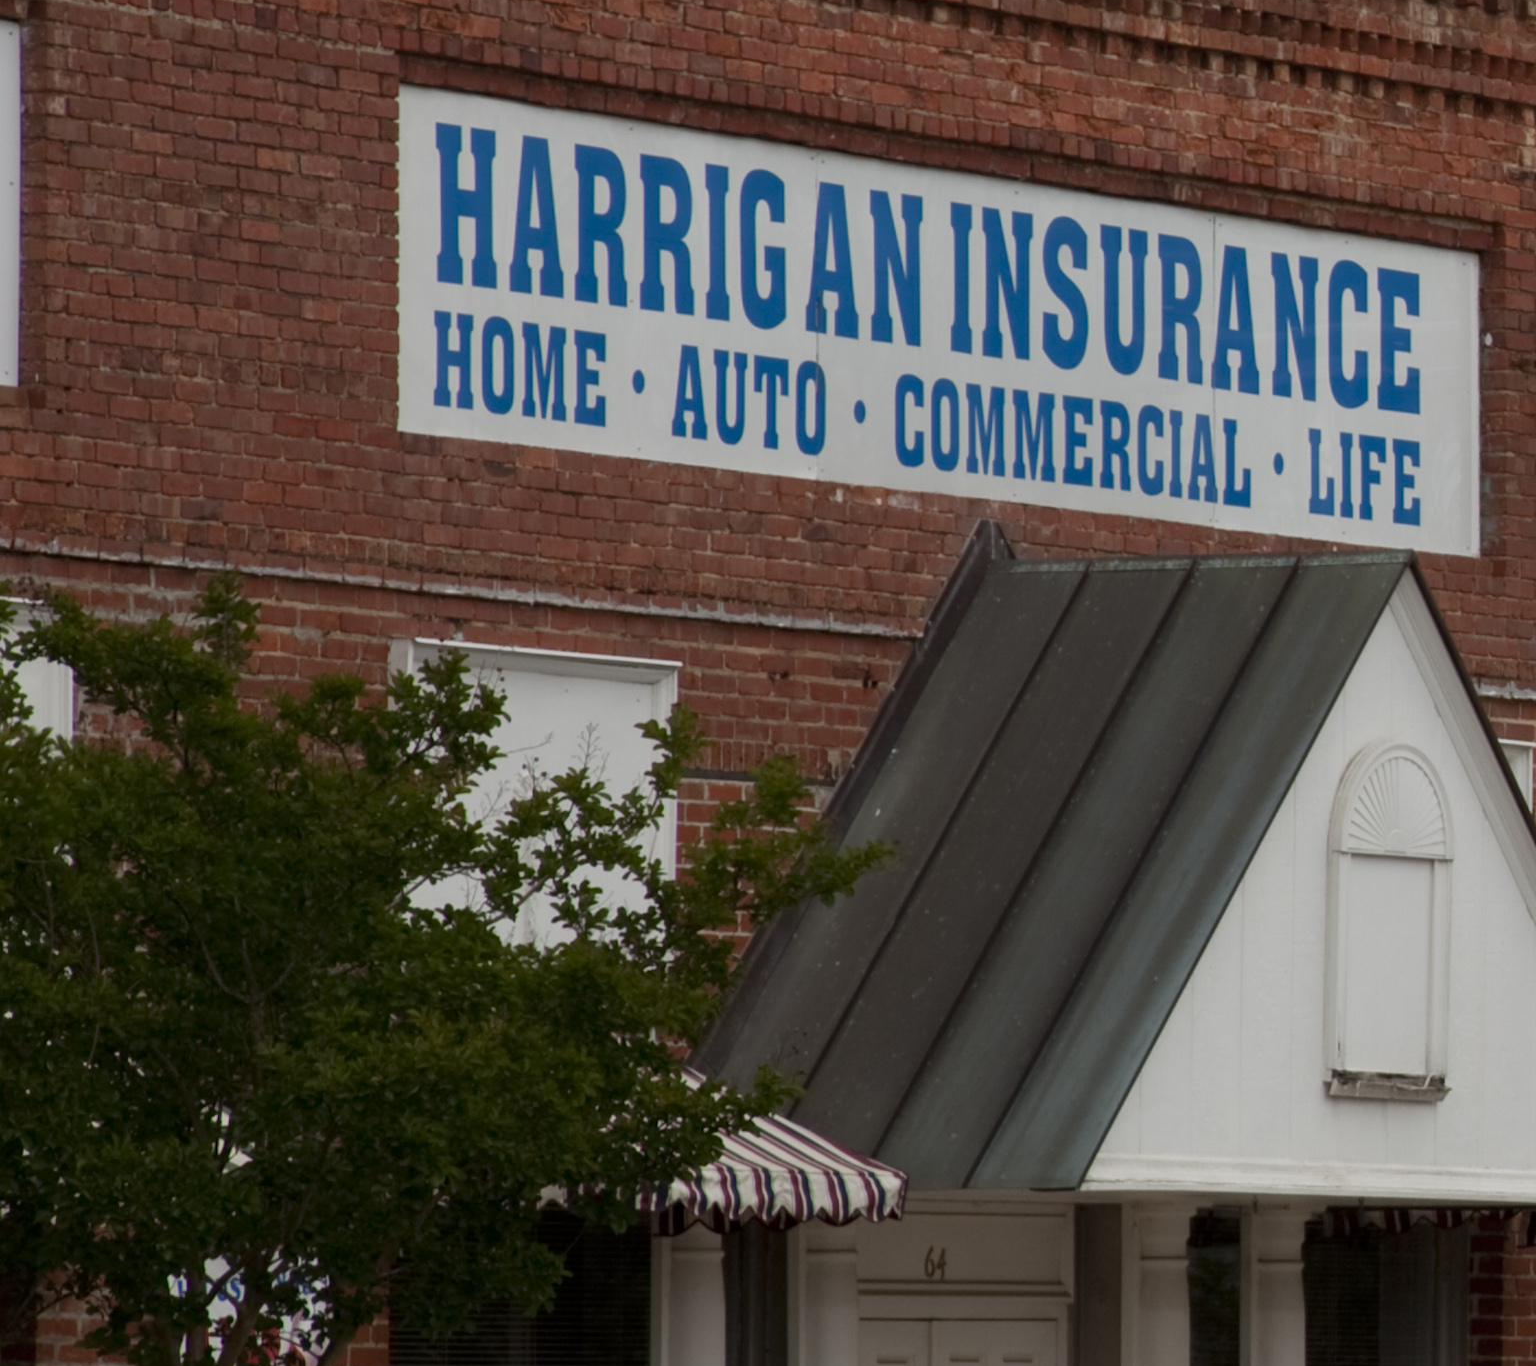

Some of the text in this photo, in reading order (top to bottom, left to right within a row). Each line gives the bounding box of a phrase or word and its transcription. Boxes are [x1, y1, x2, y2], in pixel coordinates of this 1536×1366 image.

[434, 122, 1421, 415] HARRIGAN INSURANCE
[433, 311, 1421, 527] HOME AUTO COMMERCIAL LIFE
[924, 1245, 946, 1280] 64
